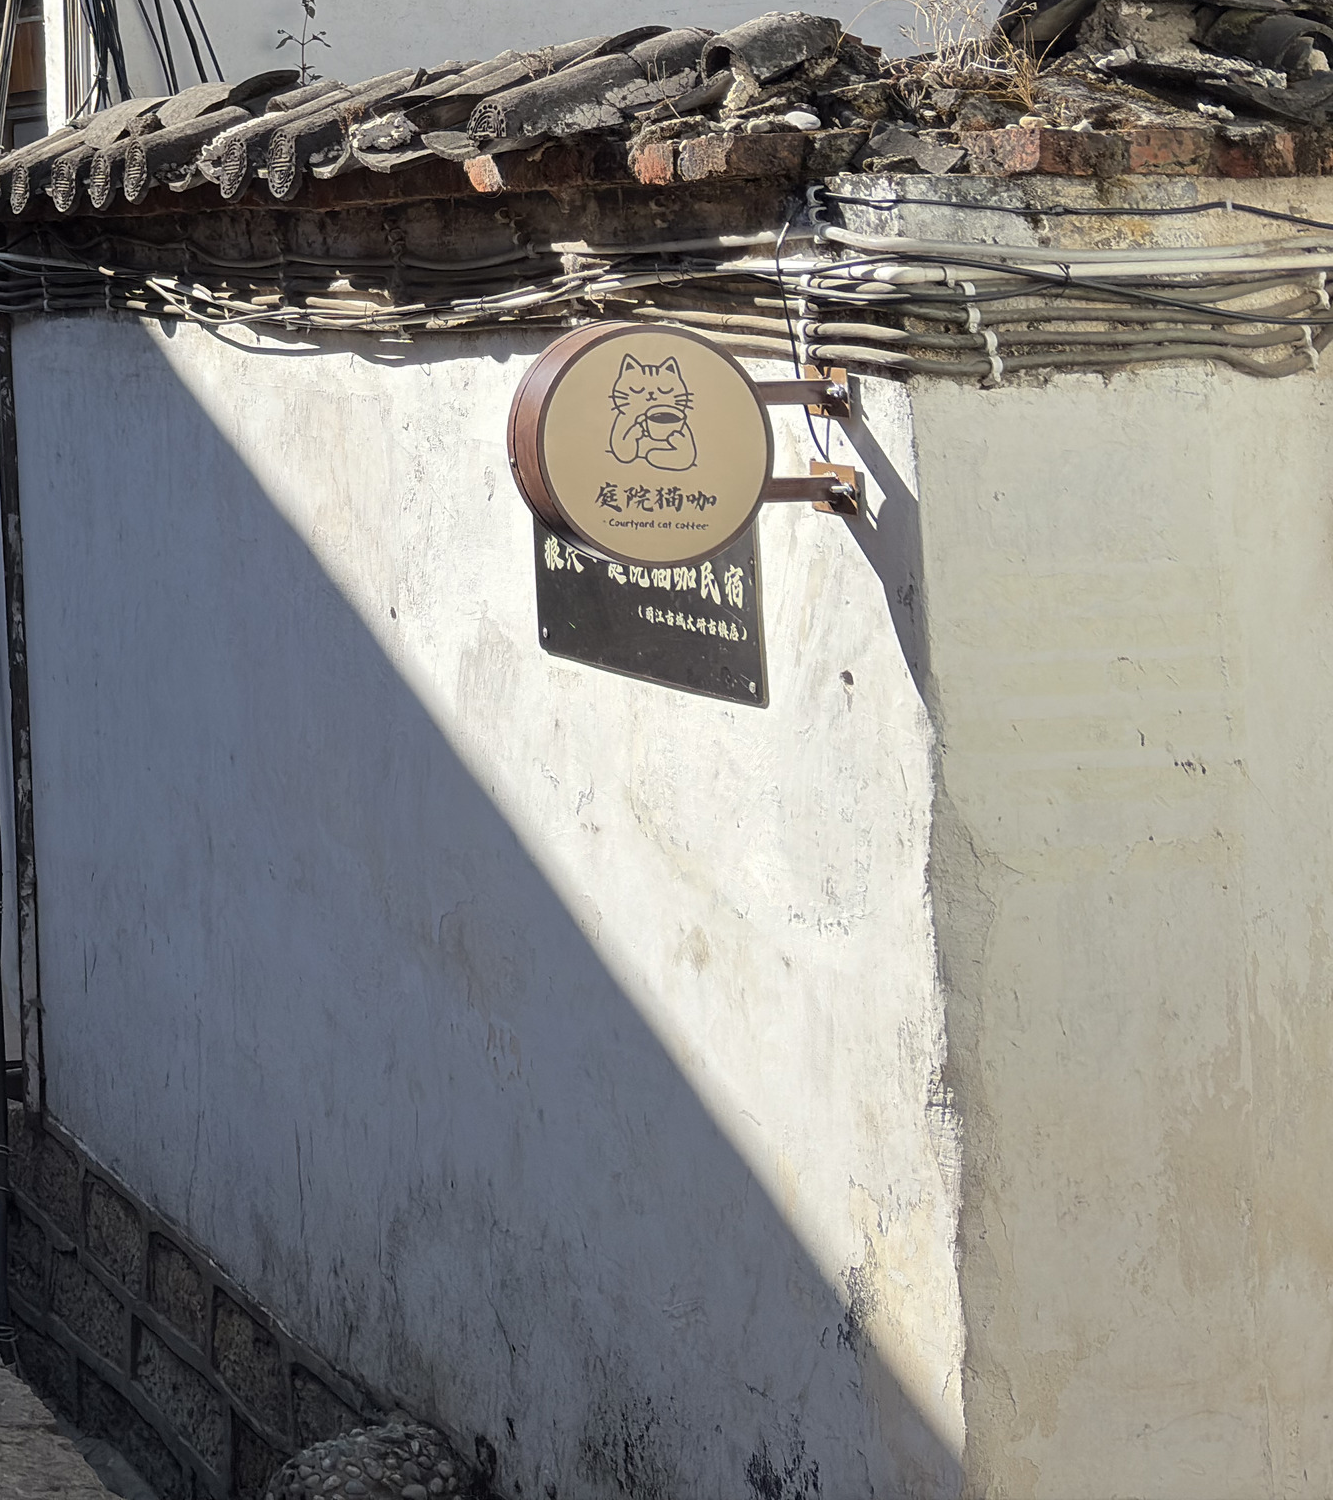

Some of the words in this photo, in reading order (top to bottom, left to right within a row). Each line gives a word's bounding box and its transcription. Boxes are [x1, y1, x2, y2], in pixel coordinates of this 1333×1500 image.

[594, 481, 718, 513] 庭院猫咖
[608, 518, 655, 530] Courtyard
[657, 521, 672, 529] cat
